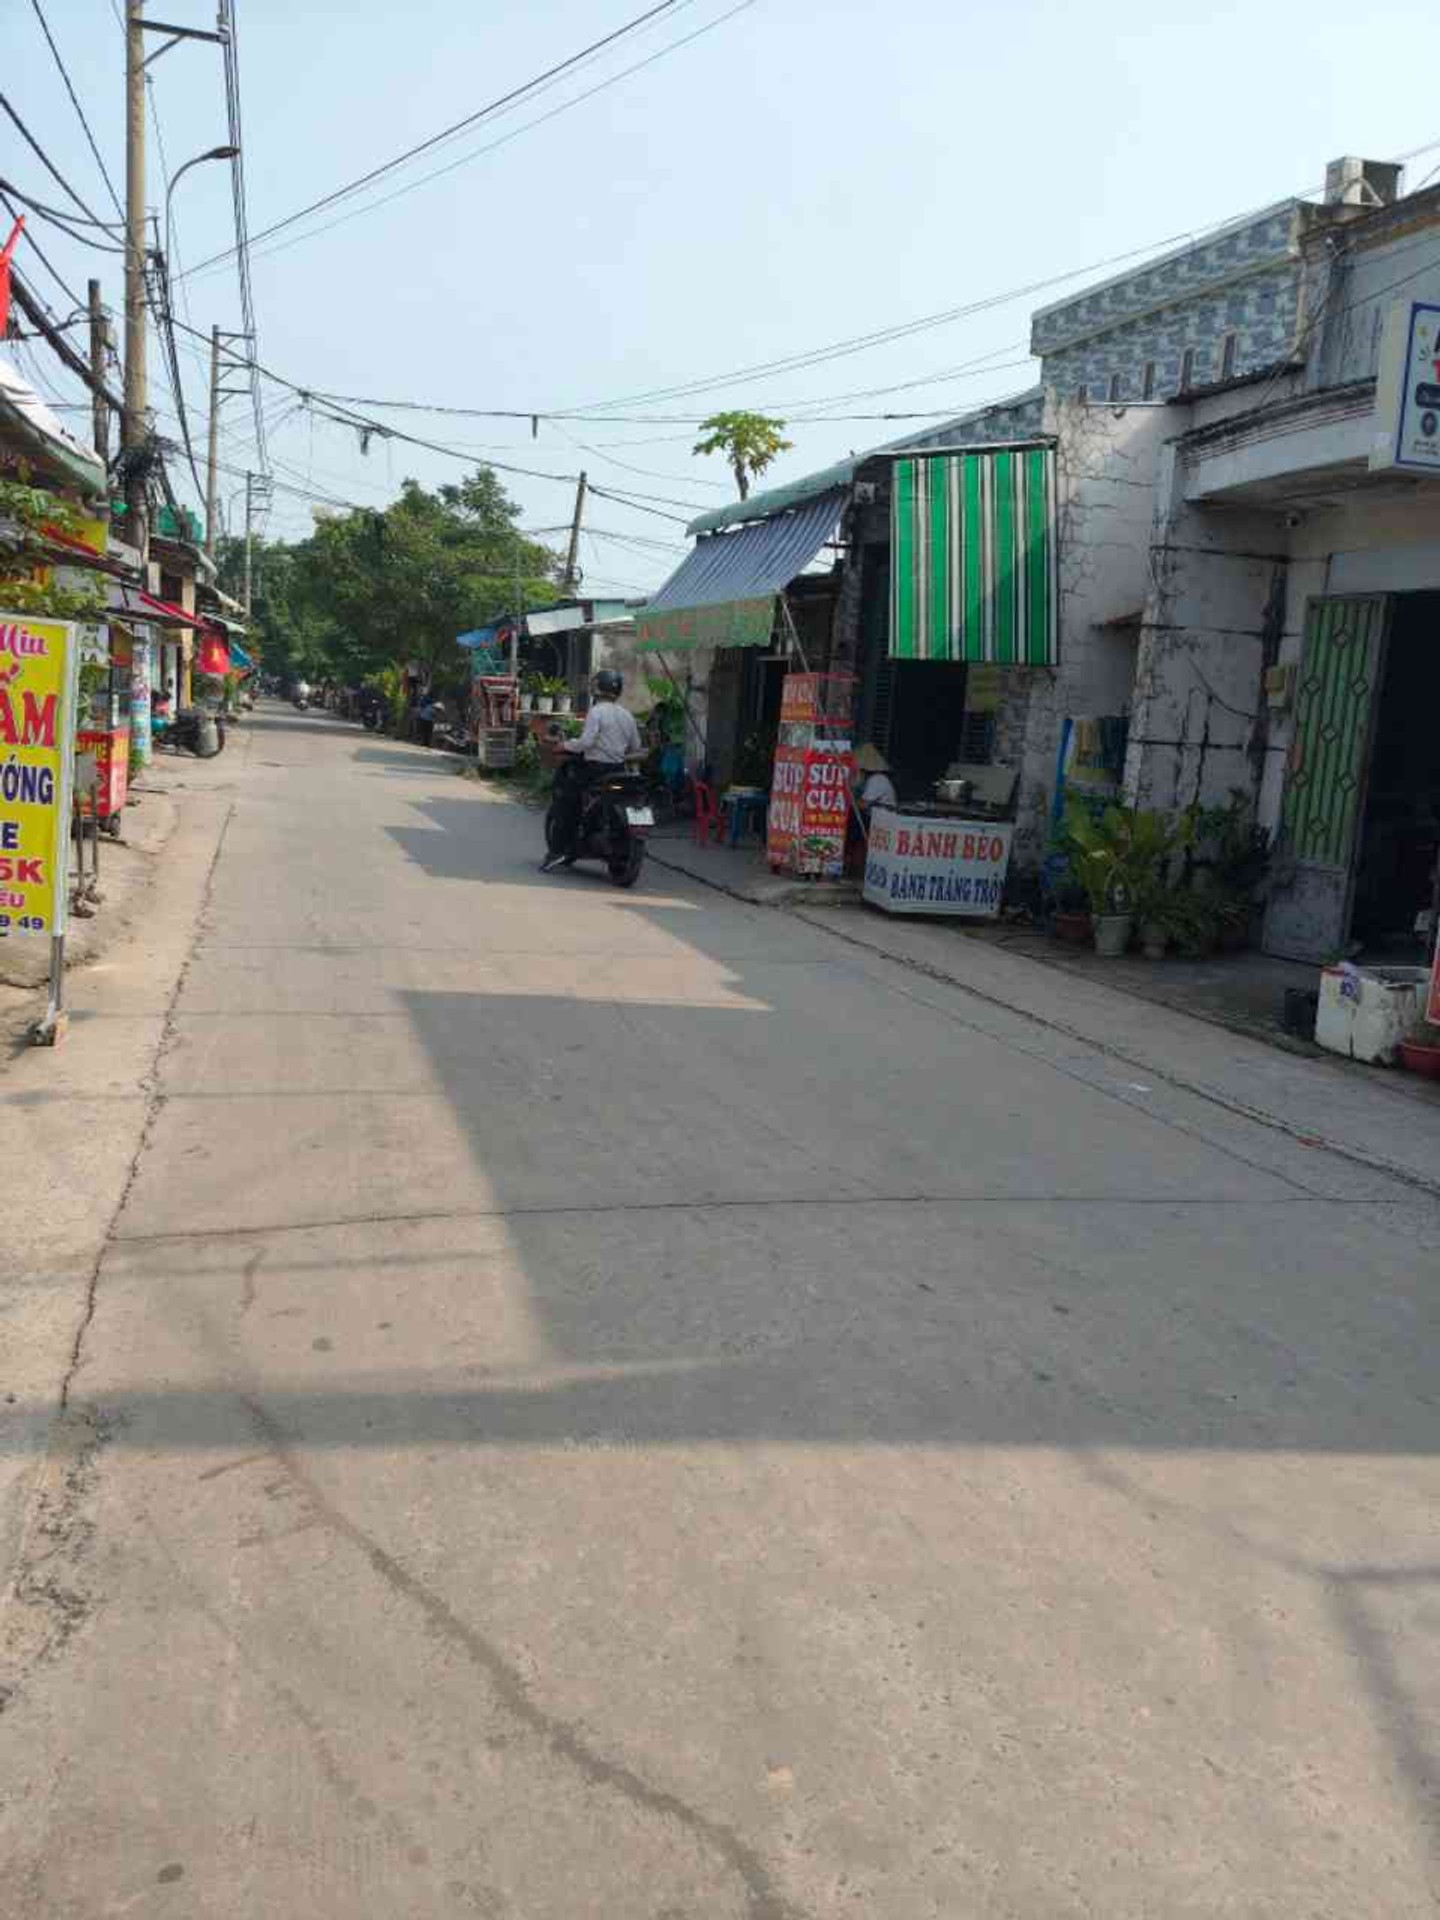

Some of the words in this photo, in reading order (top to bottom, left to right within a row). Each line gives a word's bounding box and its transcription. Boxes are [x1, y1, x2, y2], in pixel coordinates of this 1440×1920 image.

[806, 789, 846, 812] CUA
[895, 825, 957, 860] BÁNH
[18, 915, 43, 930] 49
